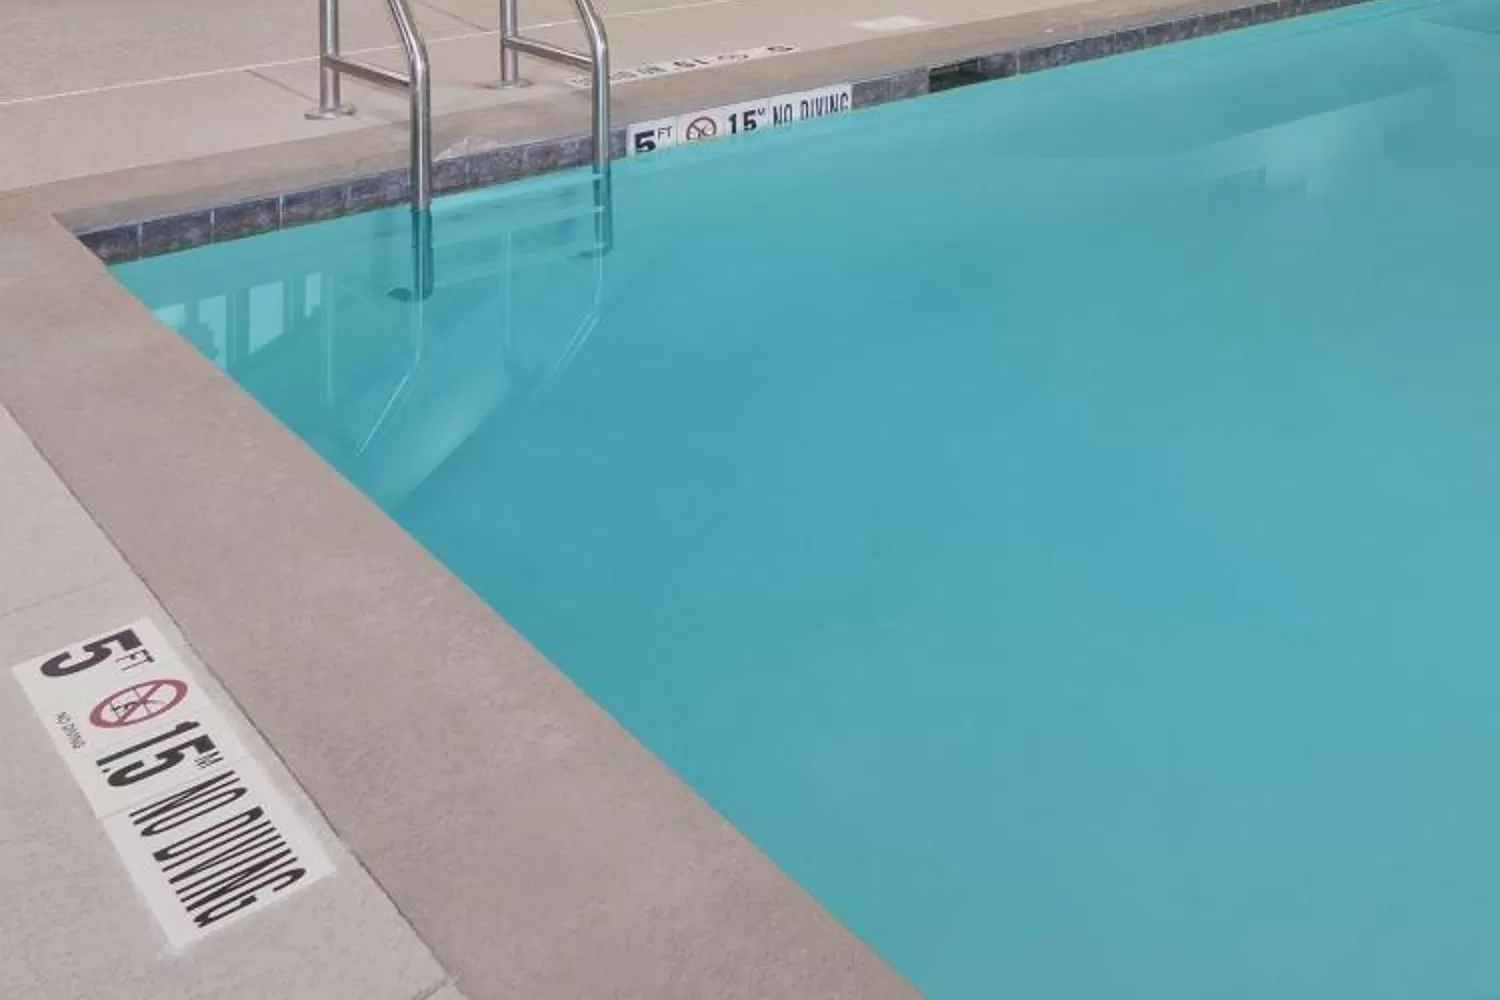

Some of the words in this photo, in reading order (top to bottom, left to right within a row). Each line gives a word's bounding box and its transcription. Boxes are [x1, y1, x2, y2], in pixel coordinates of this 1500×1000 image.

[635, 129, 656, 153] 5
[658, 125, 672, 140] FT
[773, 103, 792, 128] NO
[801, 92, 849, 121] DIVING
[40, 628, 143, 677] 5
[115, 649, 155, 671] FT
[128, 770, 247, 837] NO
[152, 805, 306, 929] DIVING
